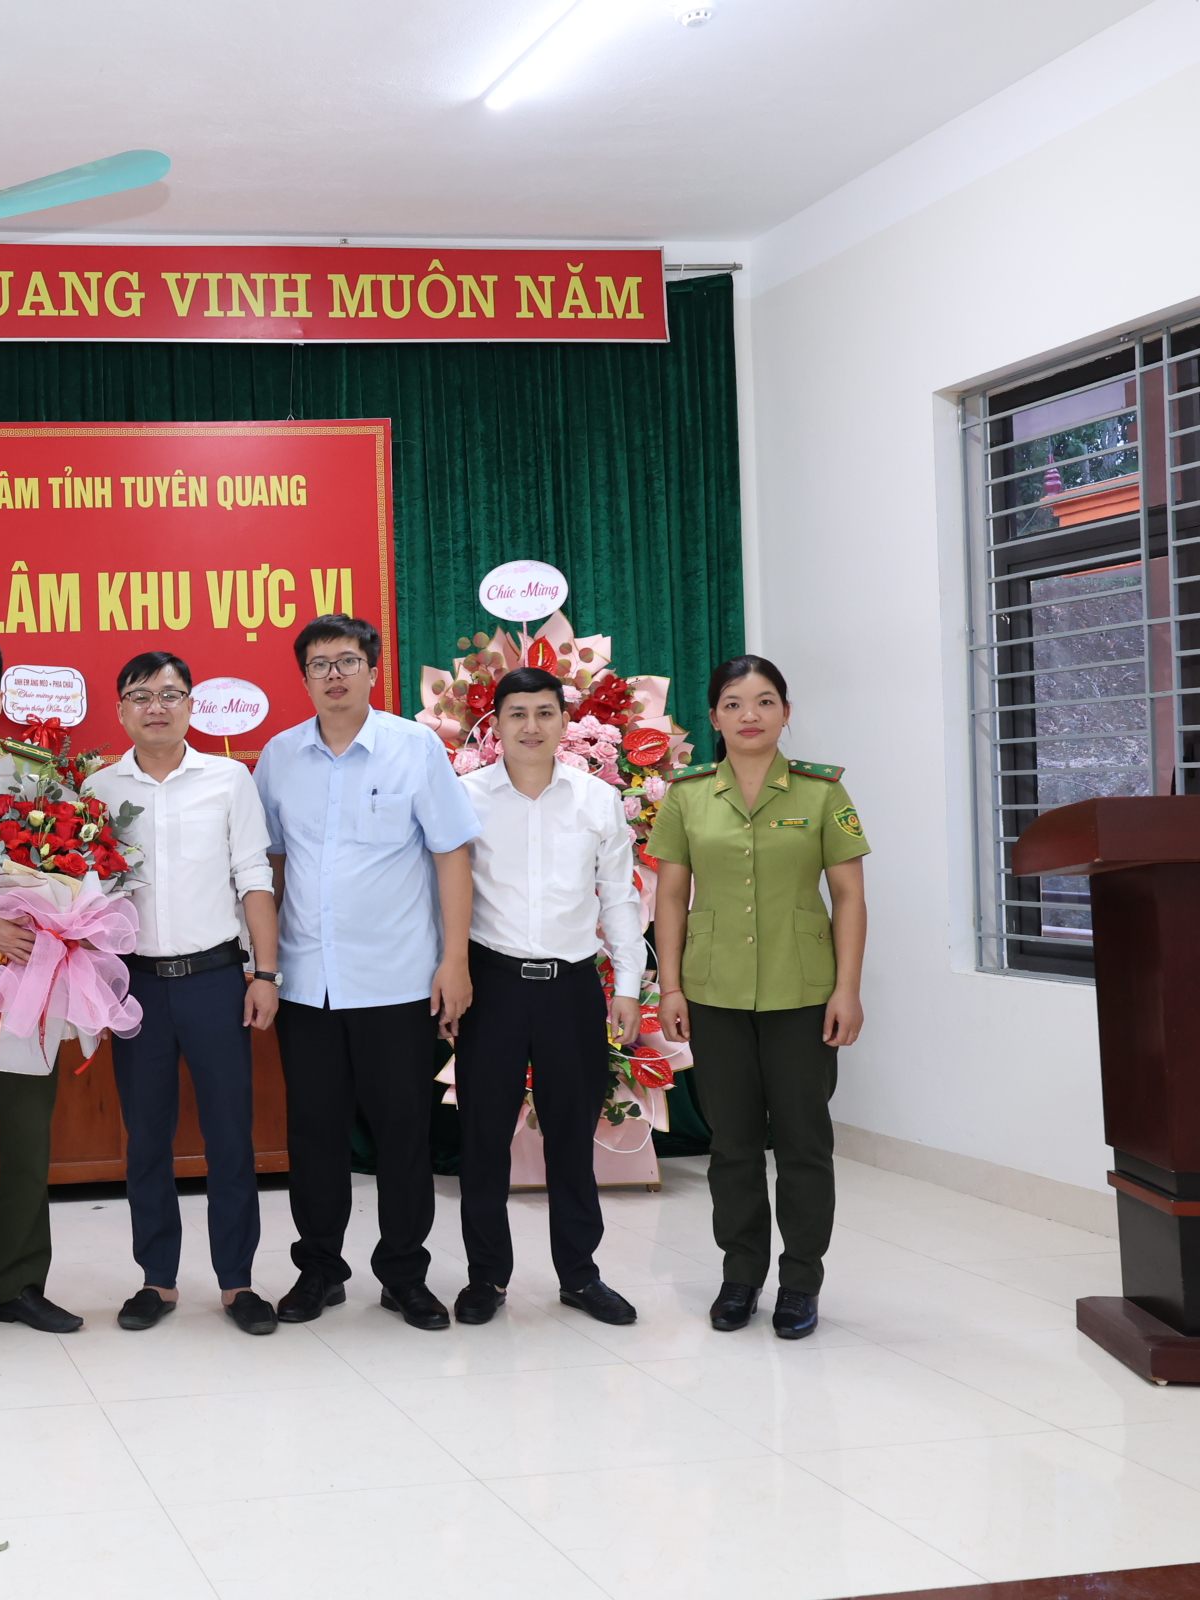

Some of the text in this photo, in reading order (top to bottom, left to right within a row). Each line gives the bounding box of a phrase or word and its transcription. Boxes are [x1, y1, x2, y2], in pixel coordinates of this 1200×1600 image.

[161, 271, 313, 319] VINH
[328, 259, 499, 320] MUÔN
[515, 263, 646, 320] NĂM
[48, 466, 112, 509] TỈNH
[120, 469, 208, 508] TUYÊN
[216, 474, 308, 511] QUANG
[98, 571, 191, 631] KHU
[206, 563, 297, 642] VỰC
[310, 568, 354, 620] VI
[487, 581, 560, 601] Chúc Mừng
[221, 698, 261, 717] Mừng
